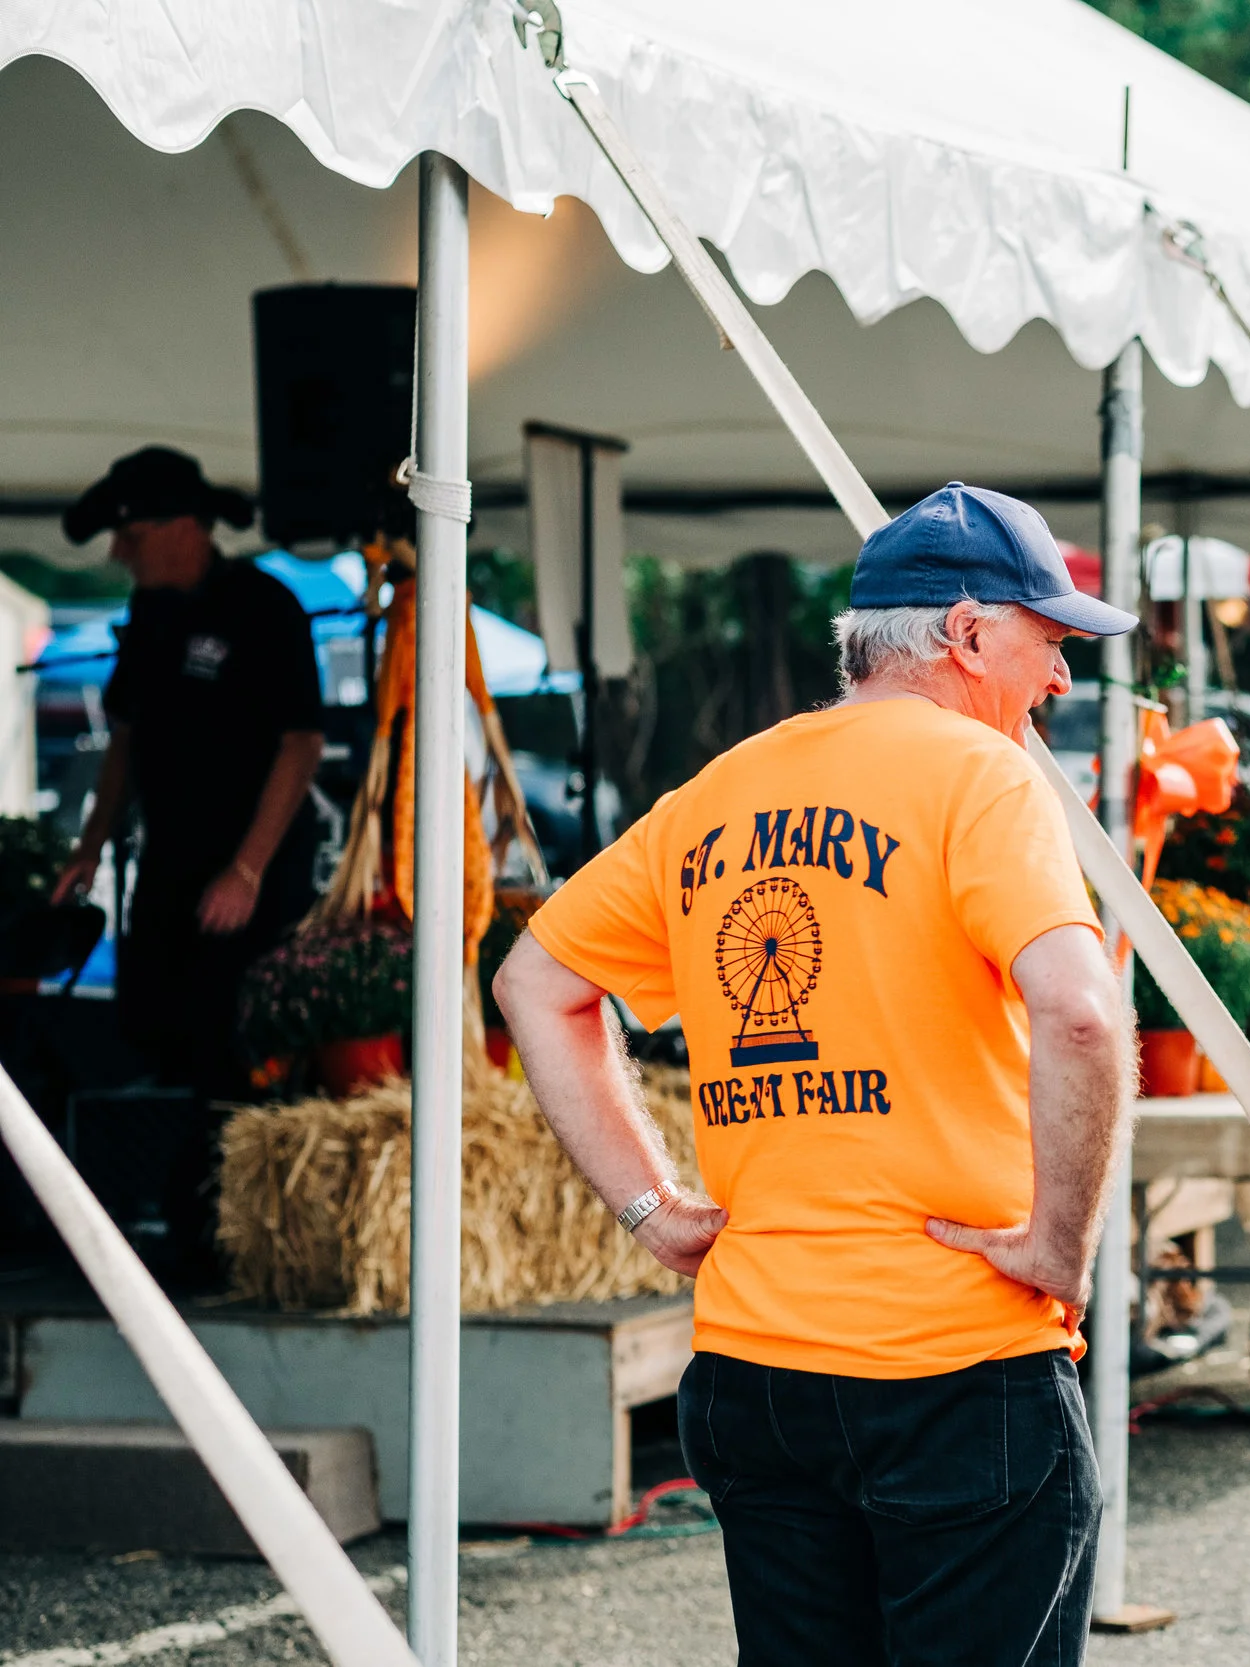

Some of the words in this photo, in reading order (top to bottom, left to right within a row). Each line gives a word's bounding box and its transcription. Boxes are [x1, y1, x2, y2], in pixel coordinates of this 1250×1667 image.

[681, 824, 726, 916] ST.
[742, 806, 901, 899] MARY
[792, 1069, 891, 1116] FAIR
